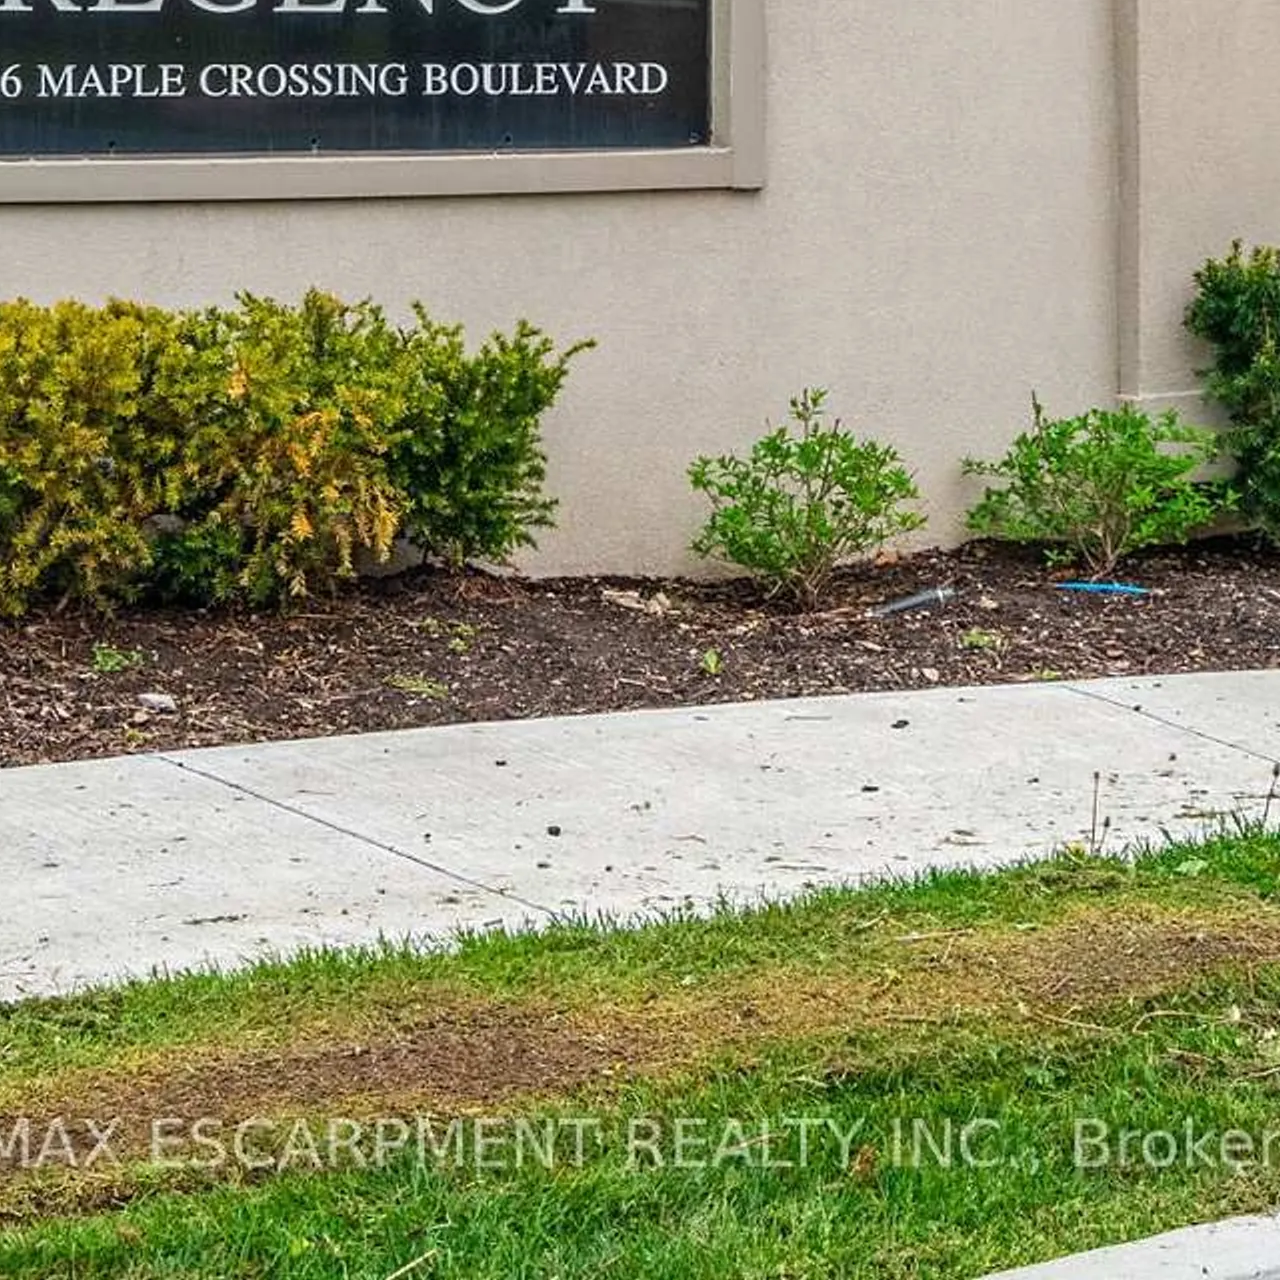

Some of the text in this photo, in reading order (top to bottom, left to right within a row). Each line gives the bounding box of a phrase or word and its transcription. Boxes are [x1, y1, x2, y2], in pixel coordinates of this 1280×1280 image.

[36, 63, 186, 98] MAPLE
[199, 62, 408, 97] CROSSING
[422, 61, 668, 96] BOULEVARD
